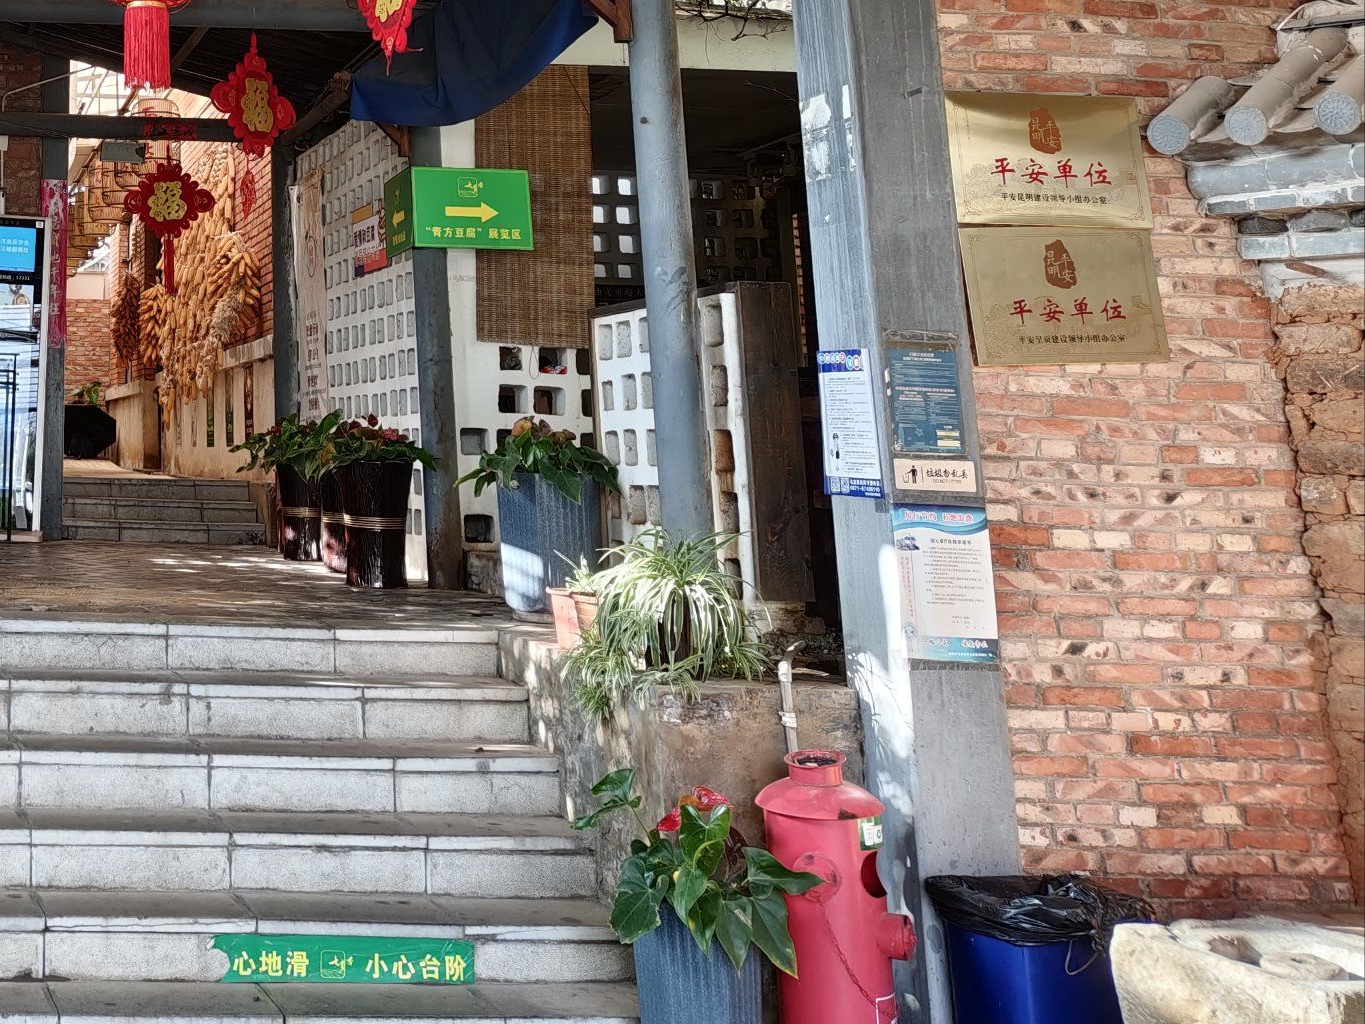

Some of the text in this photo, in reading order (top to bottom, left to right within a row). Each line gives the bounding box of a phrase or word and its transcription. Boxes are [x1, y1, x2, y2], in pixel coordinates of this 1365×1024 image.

[990, 157, 1112, 189] 平安单位
[147, 181, 188, 222] 福
[488, 228, 523, 240] 展览区
[1009, 296, 1128, 325] 平安单位
[365, 953, 467, 982] 小心台阶
